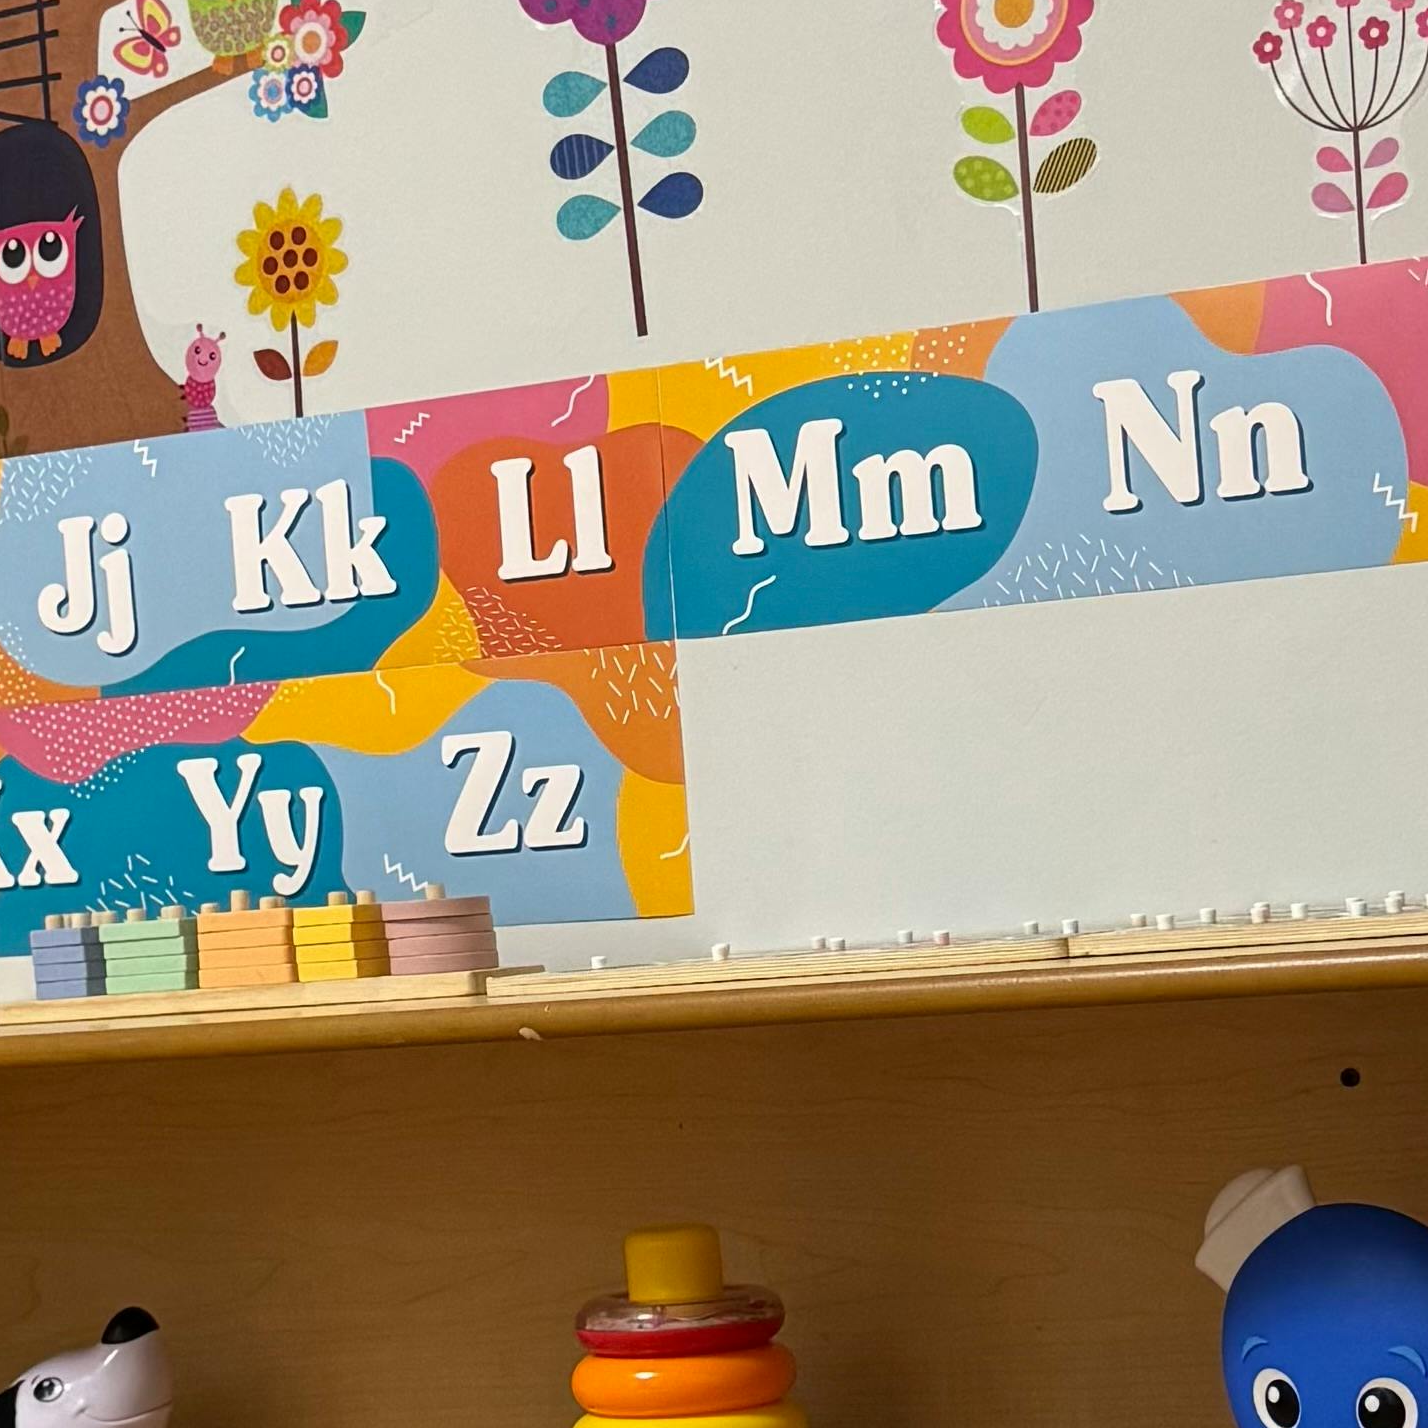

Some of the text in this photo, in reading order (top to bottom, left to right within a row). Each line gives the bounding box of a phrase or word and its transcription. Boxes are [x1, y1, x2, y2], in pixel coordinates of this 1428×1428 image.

[38, 512, 135, 656] Jj
[224, 480, 397, 612] Kk
[492, 446, 614, 581] Ll
[725, 418, 982, 558] Mm
[1092, 370, 1310, 513] Nn
[177, 754, 323, 897] Yy
[441, 730, 586, 856] Zz
